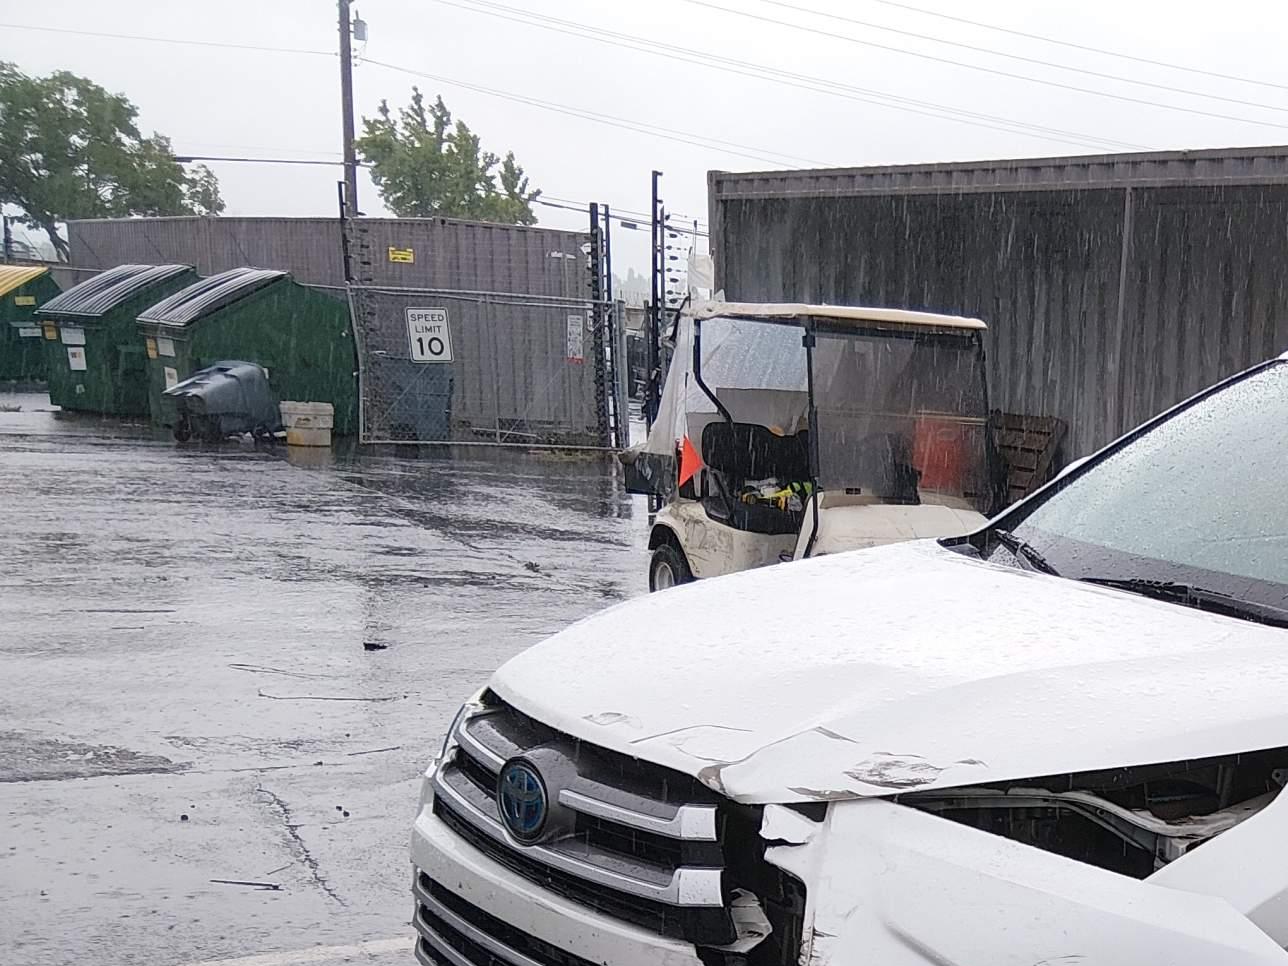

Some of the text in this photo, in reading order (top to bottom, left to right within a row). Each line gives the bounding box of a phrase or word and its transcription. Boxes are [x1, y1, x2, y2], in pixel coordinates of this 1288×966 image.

[410, 313, 444, 322] SPEED
[415, 325, 442, 333] LIMIT
[417, 337, 444, 356] 10
